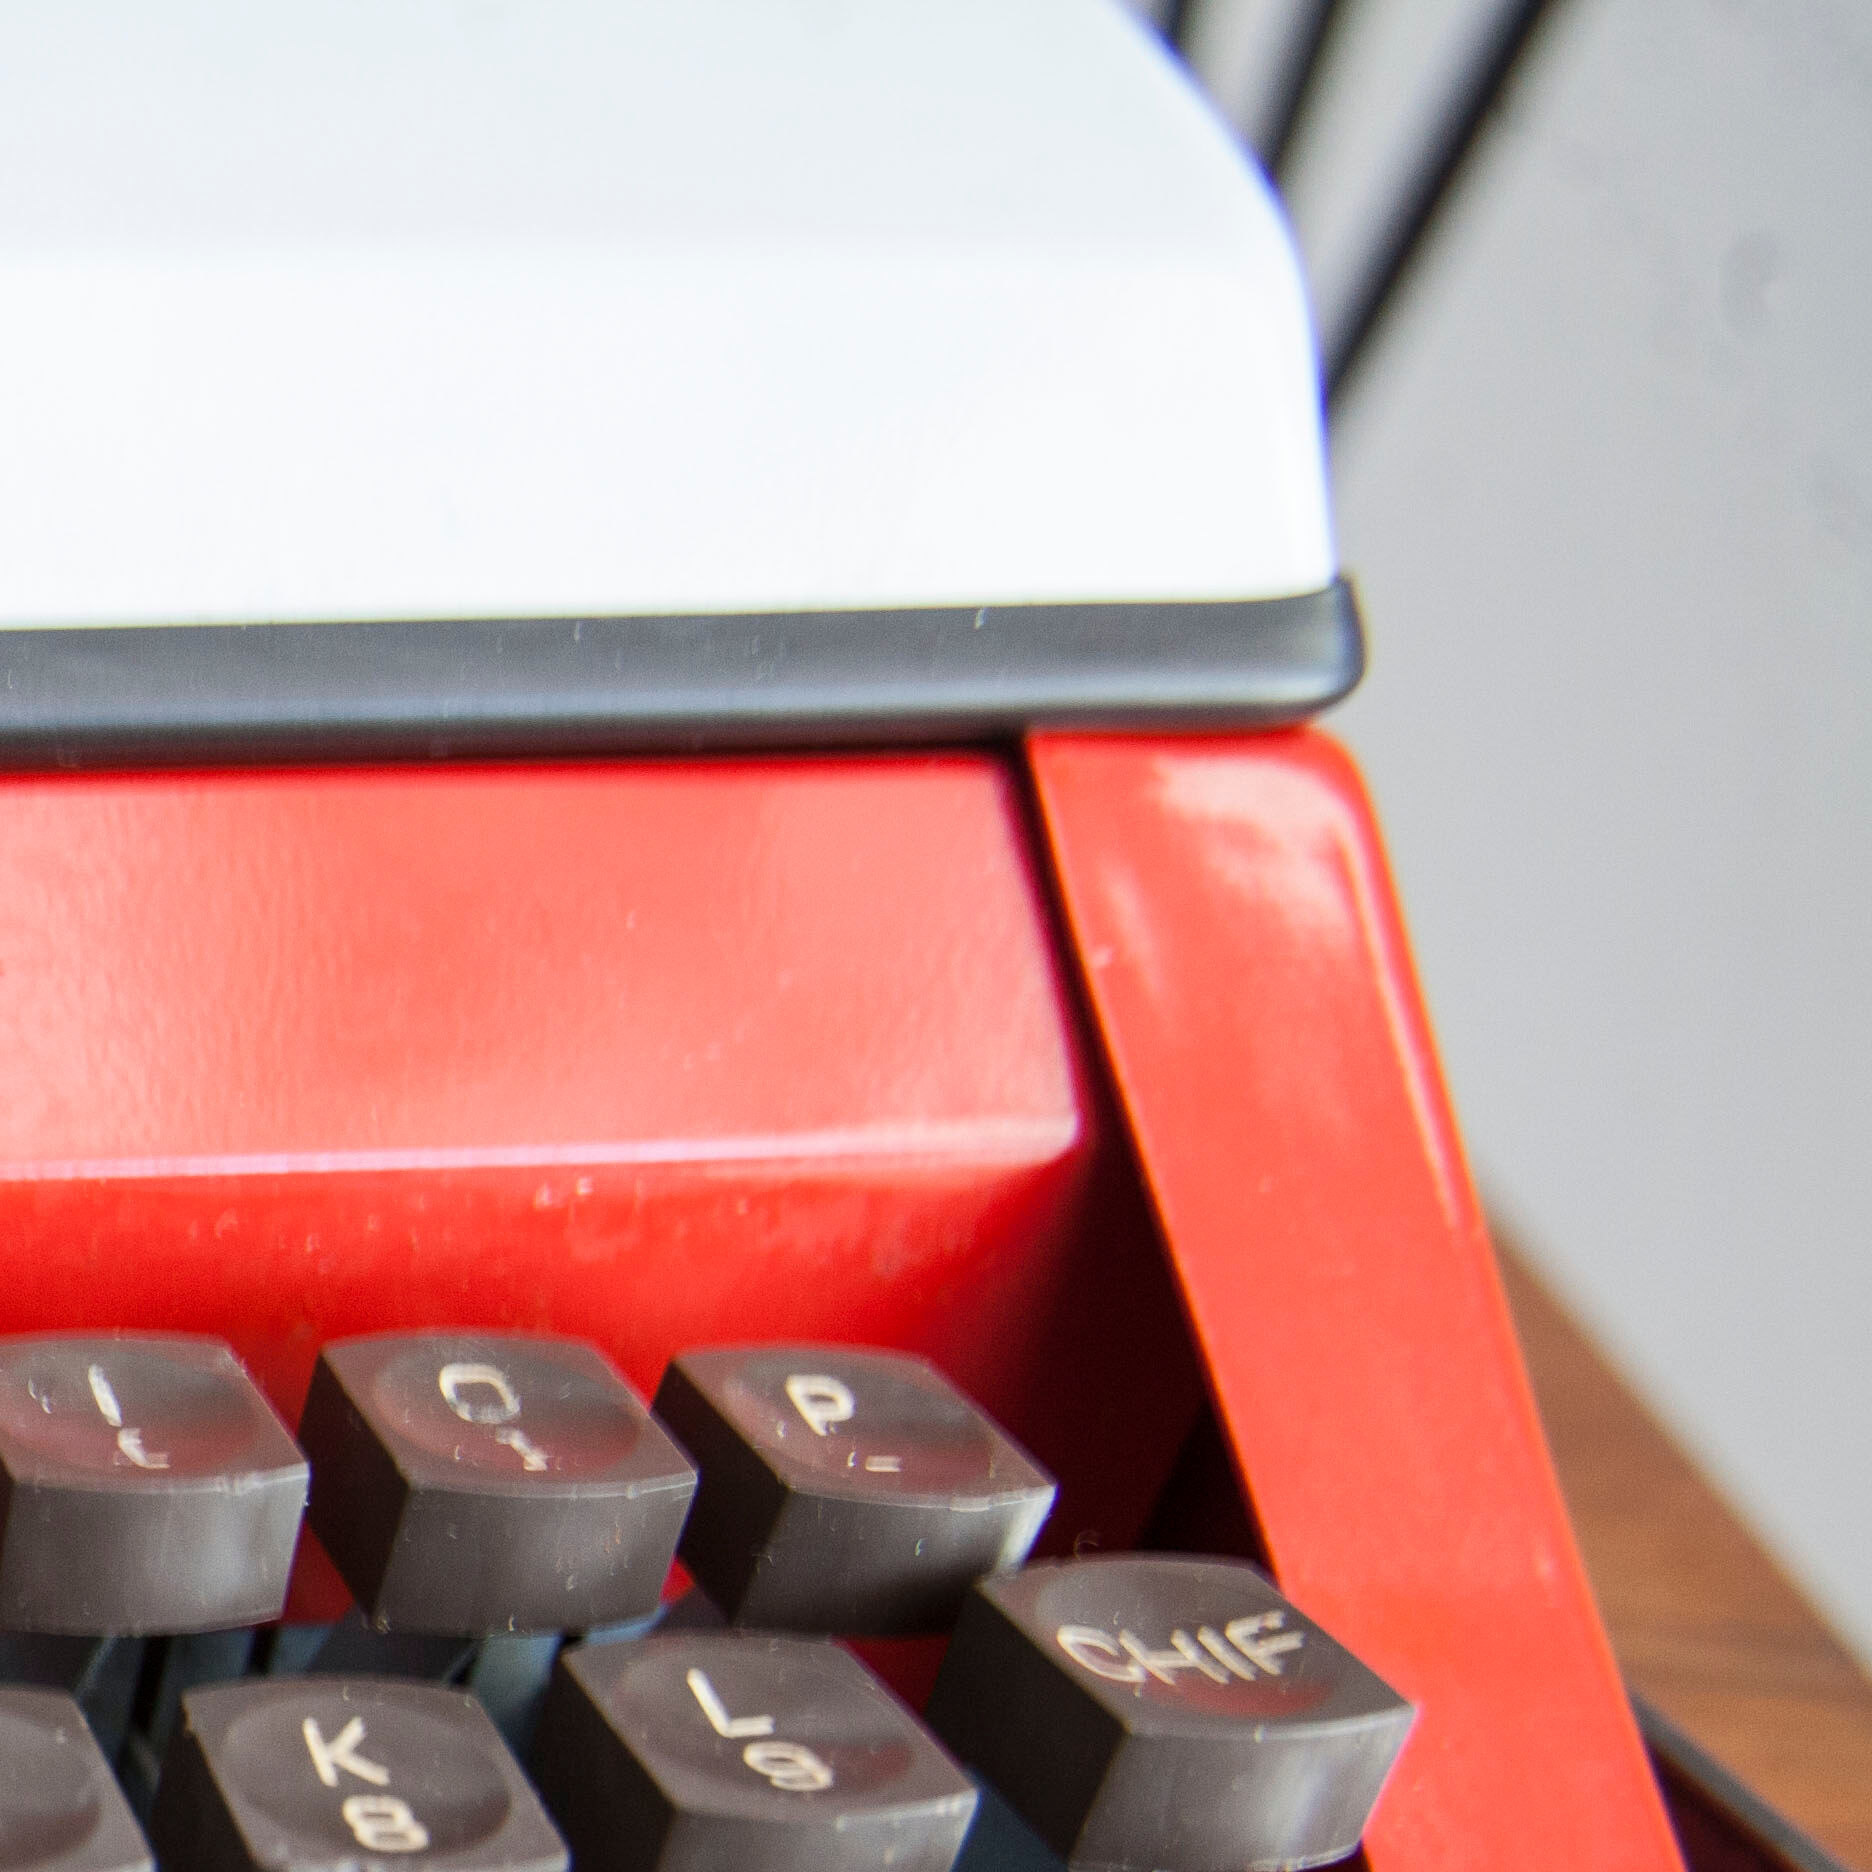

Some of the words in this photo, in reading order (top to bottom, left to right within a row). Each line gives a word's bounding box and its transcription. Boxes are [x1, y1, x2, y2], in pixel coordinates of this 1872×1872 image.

[87, 1362, 122, 1428] I
[439, 1362, 522, 1424] O
[785, 1373, 856, 1436] P
[1057, 1610, 1306, 1686] CHIF
[686, 1667, 776, 1738] L
[302, 1716, 392, 1788] K
[342, 1793, 431, 1854] 8
